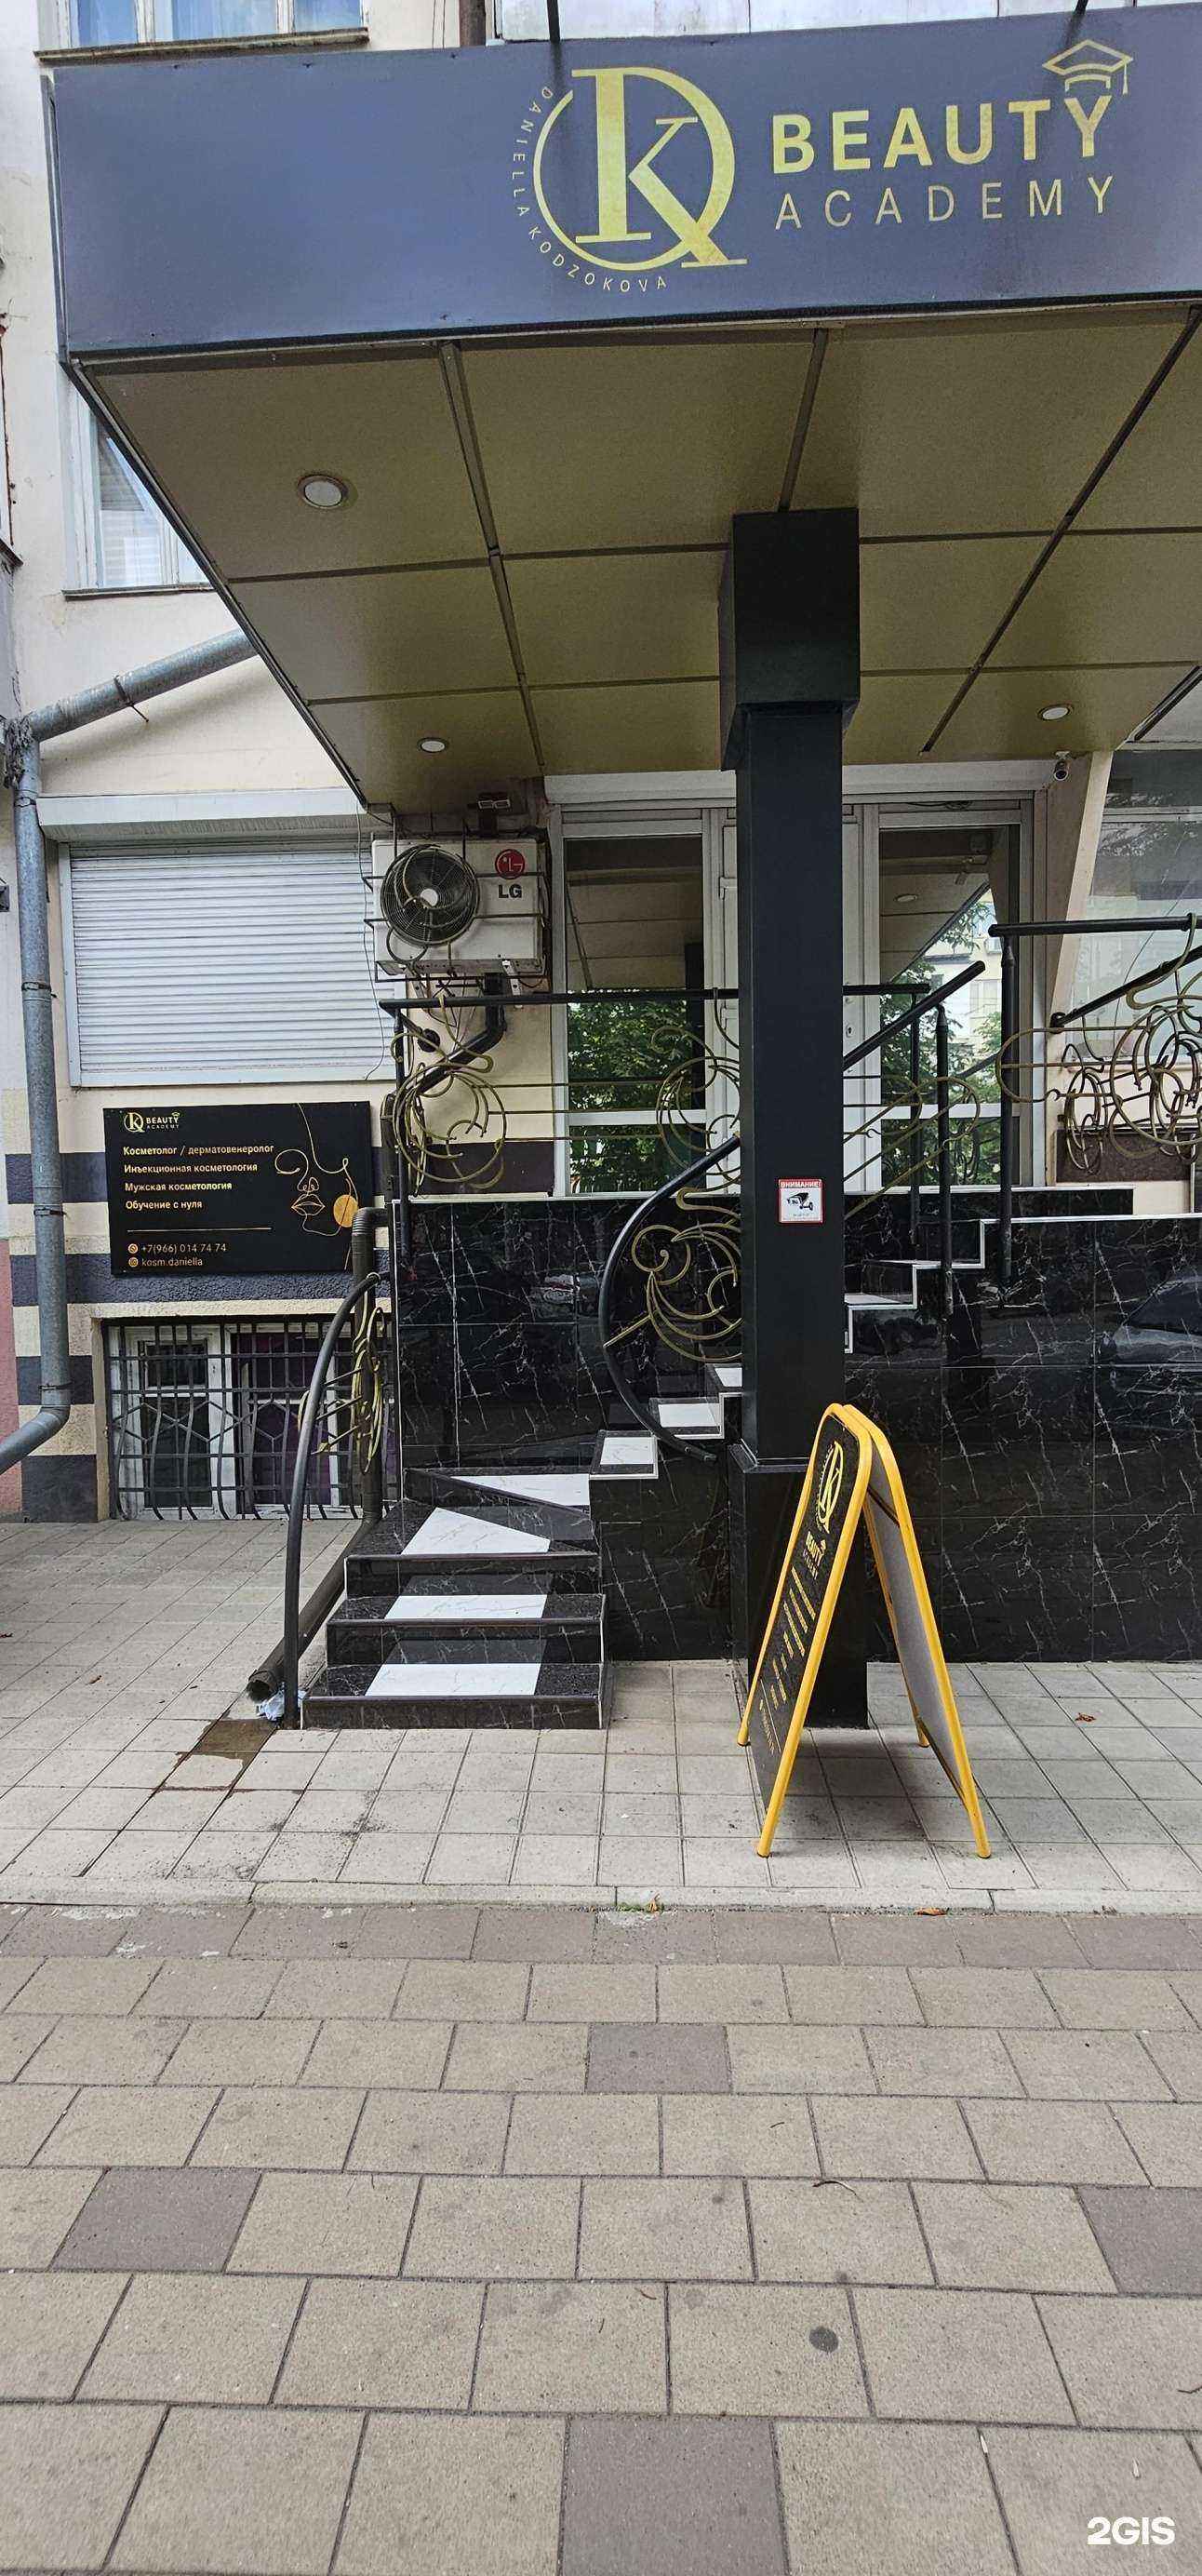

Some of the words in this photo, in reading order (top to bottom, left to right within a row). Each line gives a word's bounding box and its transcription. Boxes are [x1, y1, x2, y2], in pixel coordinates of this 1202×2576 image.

[772, 94, 1114, 174] BEAUTY
[512, 86, 554, 217] DANIELLA
[774, 175, 1115, 231] ACADEMY
[528, 226, 668, 292] KODZOKOVA
[498, 884, 523, 899] LG
[146, 1116, 180, 1124] BEAUTY
[123, 1146, 178, 1156] Косметолог
[188, 1144, 274, 1156] дерматовенеролог
[124, 1163, 192, 1174] Инъекционная
[194, 1162, 258, 1173] косметология
[125, 1182, 167, 1194] Мужская
[168, 1181, 233, 1191] косметология
[125, 1199, 171, 1212] Обучение
[180, 1201, 203, 1211] нуля
[140, 1243, 177, 1254] +7(966)
[180, 1243, 197, 1253] 014
[200, 1242, 212, 1253] 74
[215, 1242, 227, 1252] 74
[141, 1256, 204, 1267] kosm.daniella
[805, 1530, 824, 1567] BEAUTY
